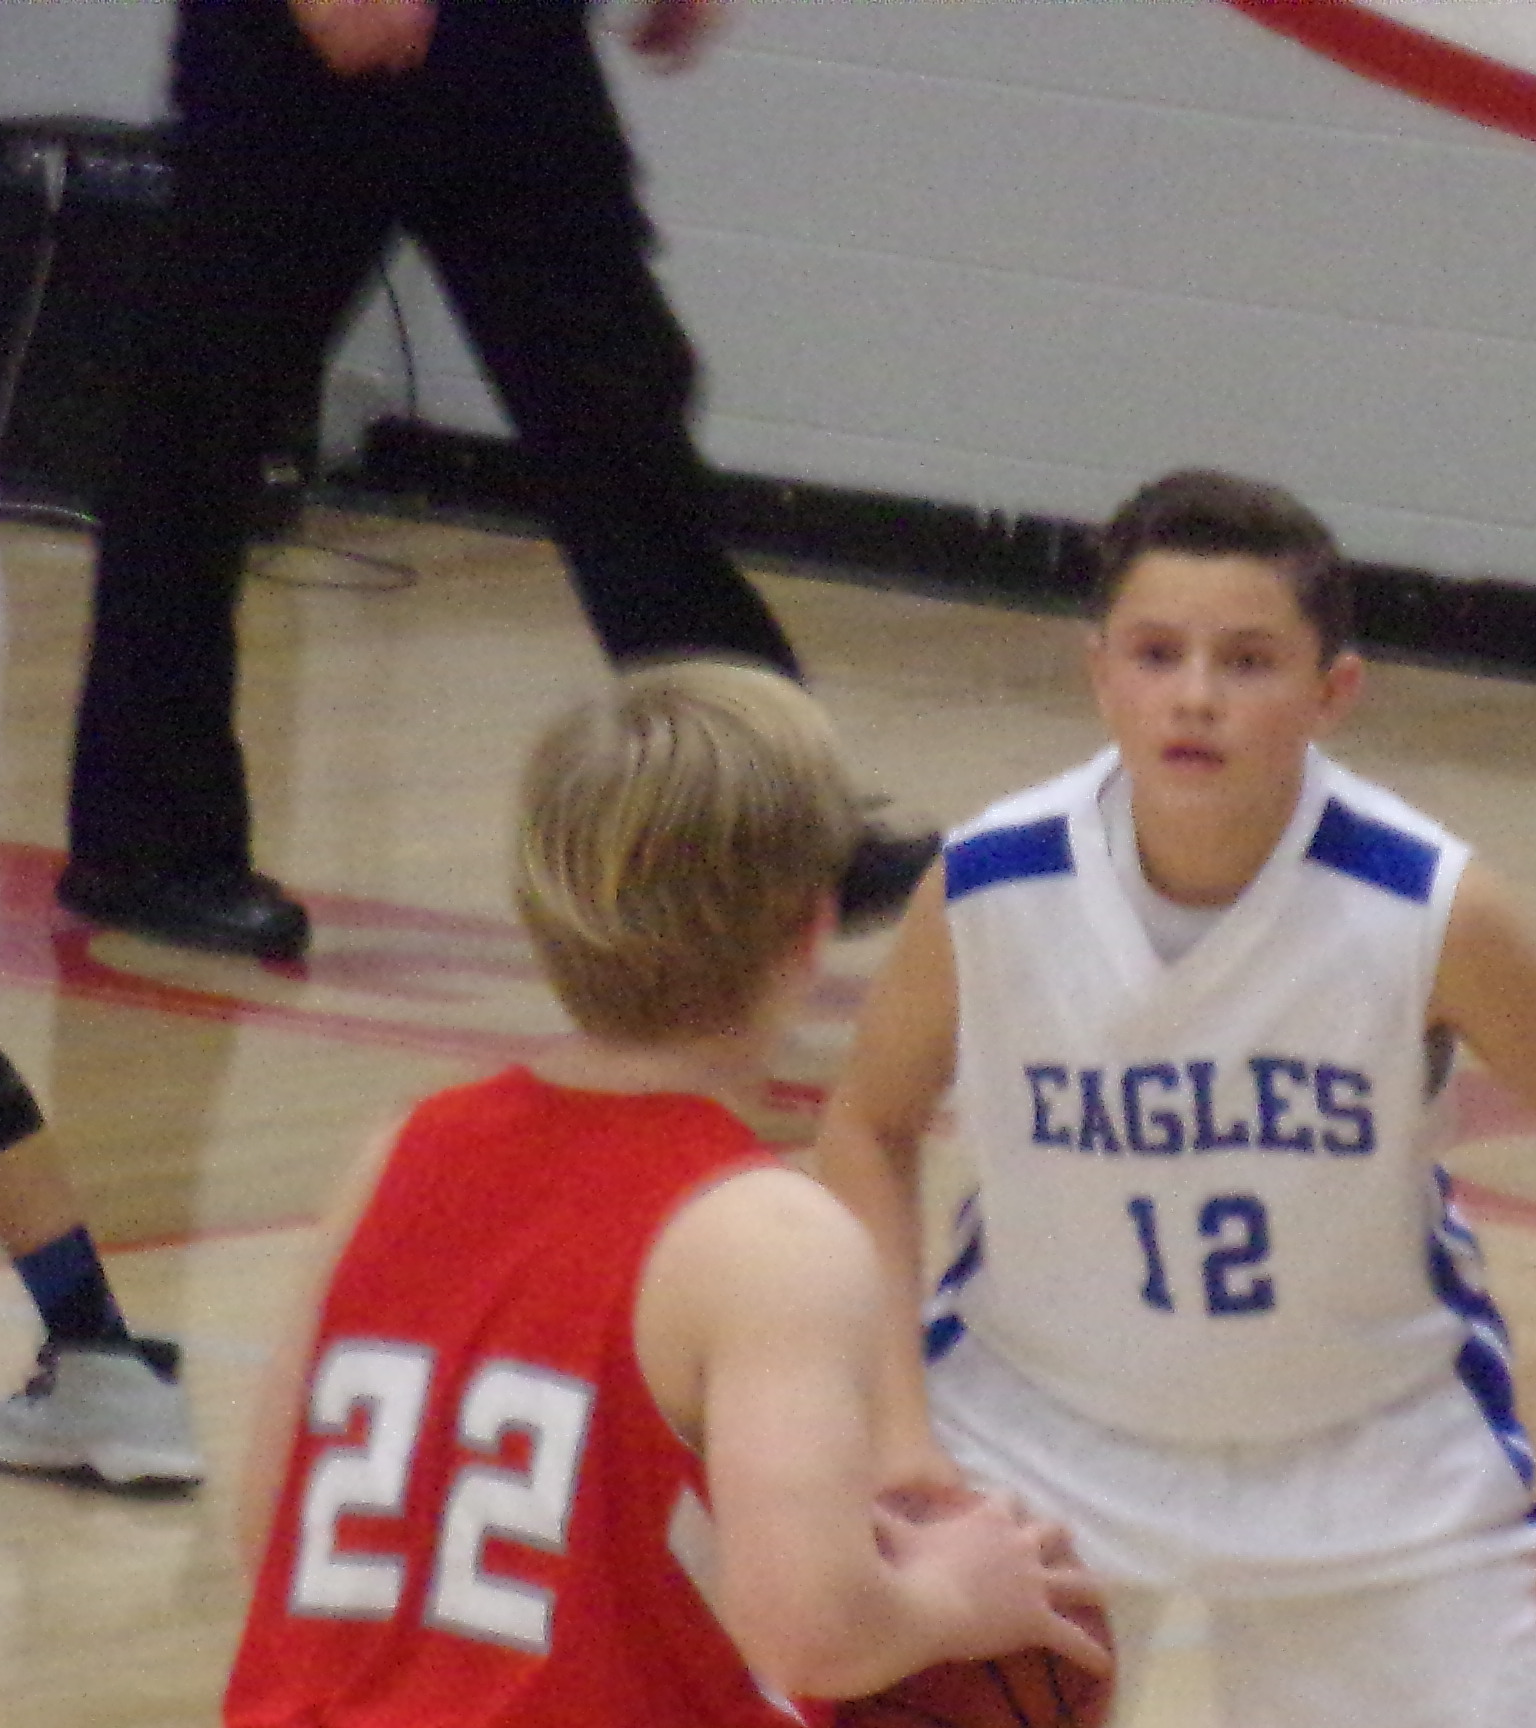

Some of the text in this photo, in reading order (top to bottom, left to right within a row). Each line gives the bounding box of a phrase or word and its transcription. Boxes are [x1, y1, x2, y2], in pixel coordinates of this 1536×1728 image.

[1024, 1058, 1378, 1156] EAGLES
[1128, 1196, 1276, 1315] 12
[286, 1334, 599, 1655] 22
